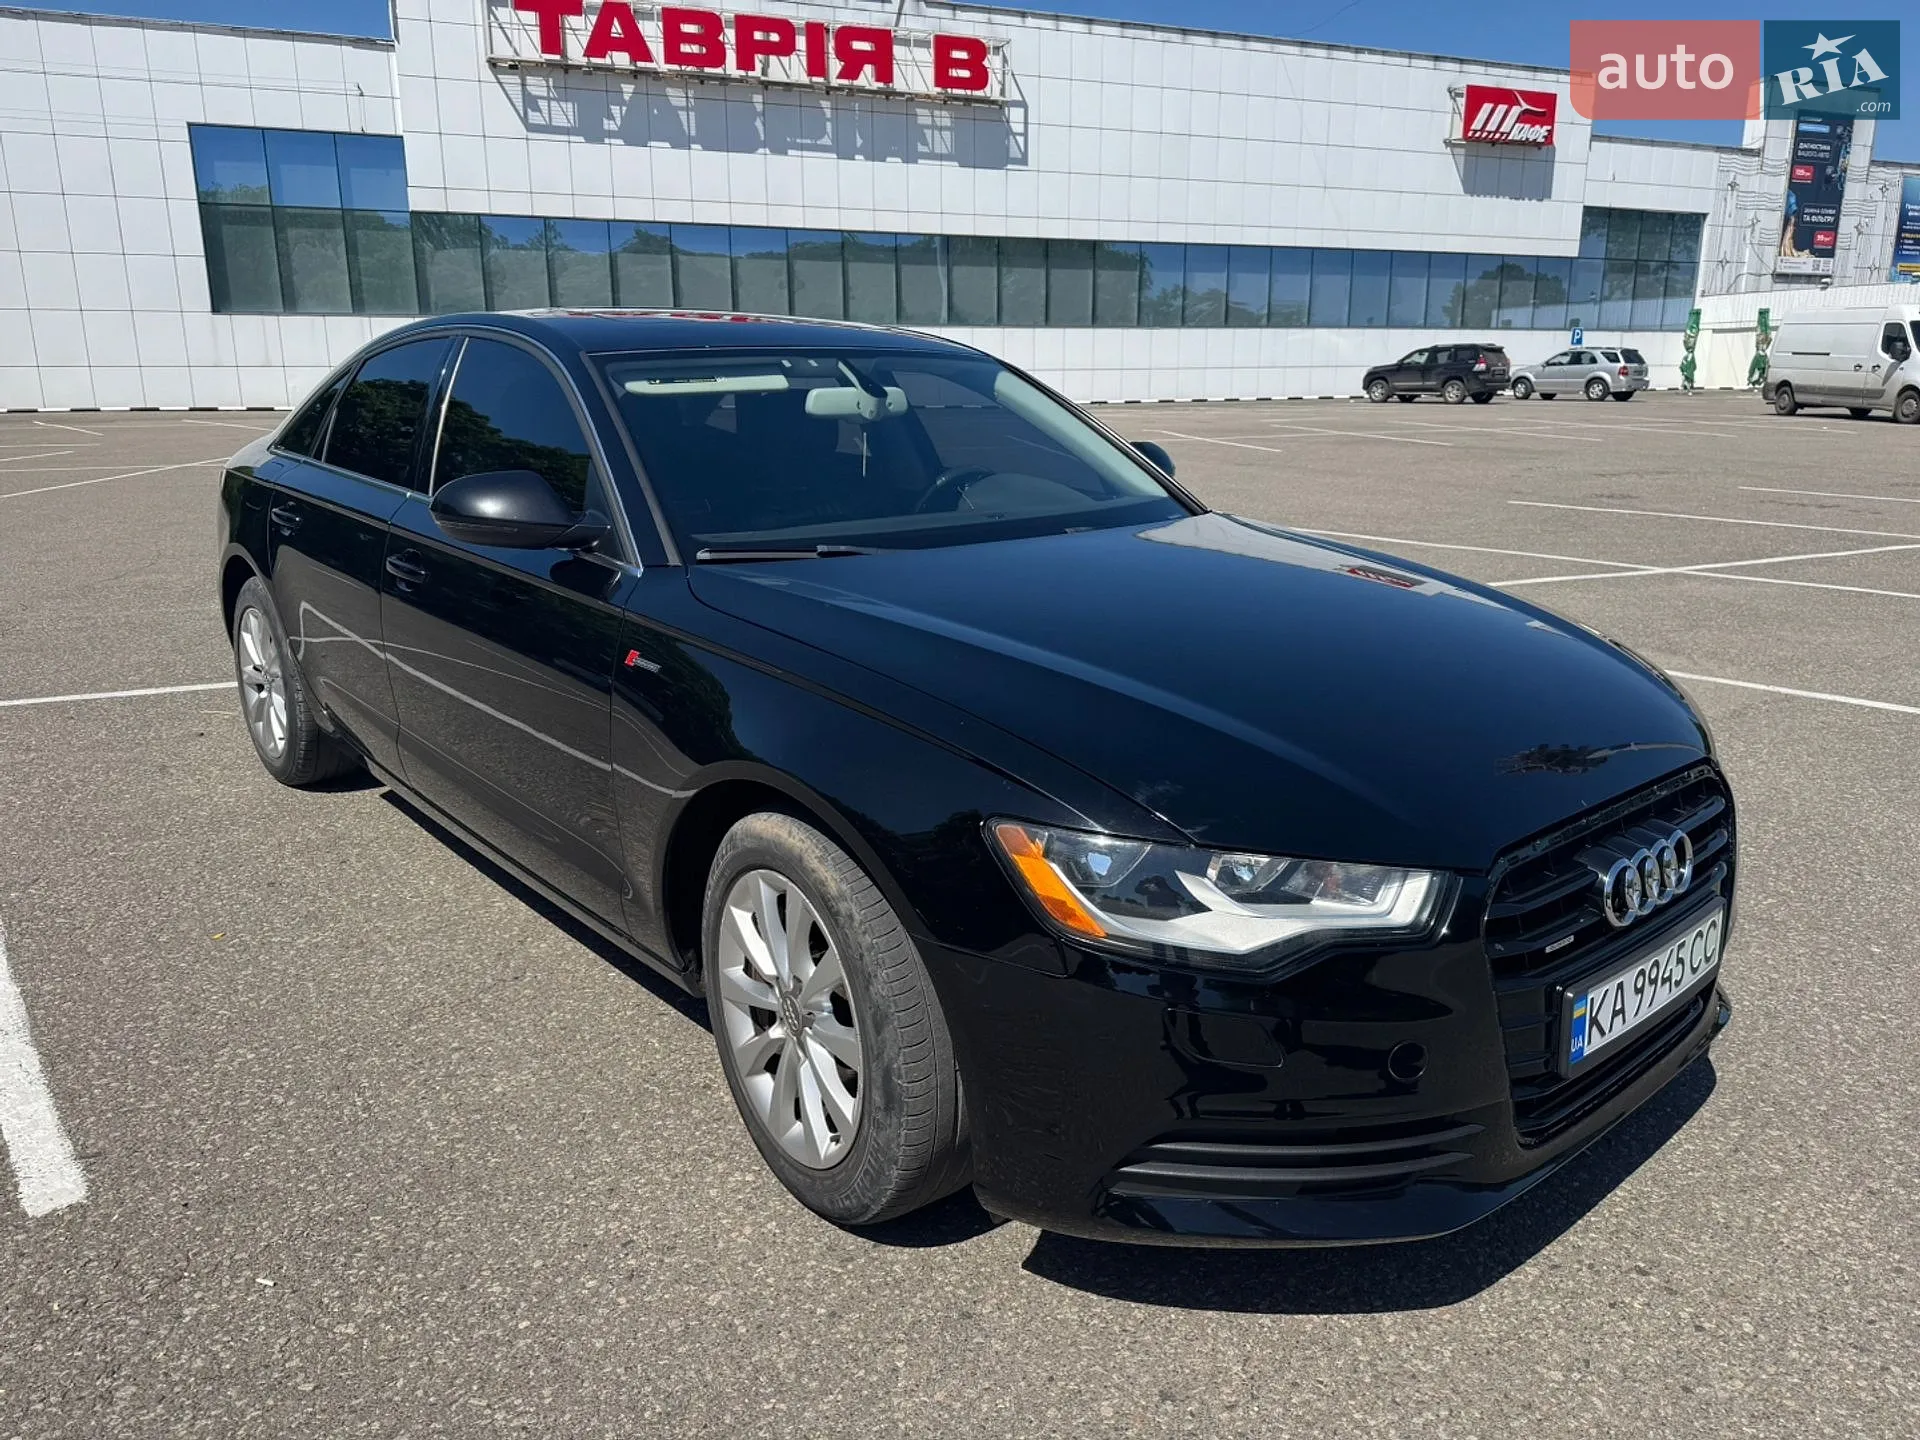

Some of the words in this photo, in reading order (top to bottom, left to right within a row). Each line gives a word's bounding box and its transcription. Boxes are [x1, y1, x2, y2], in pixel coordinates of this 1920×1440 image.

[514, 0, 894, 84] ТАВРІЯ
[934, 34, 989, 92] В
[1574, 329, 1581, 344] P
[1571, 1034, 1583, 1052] UA
